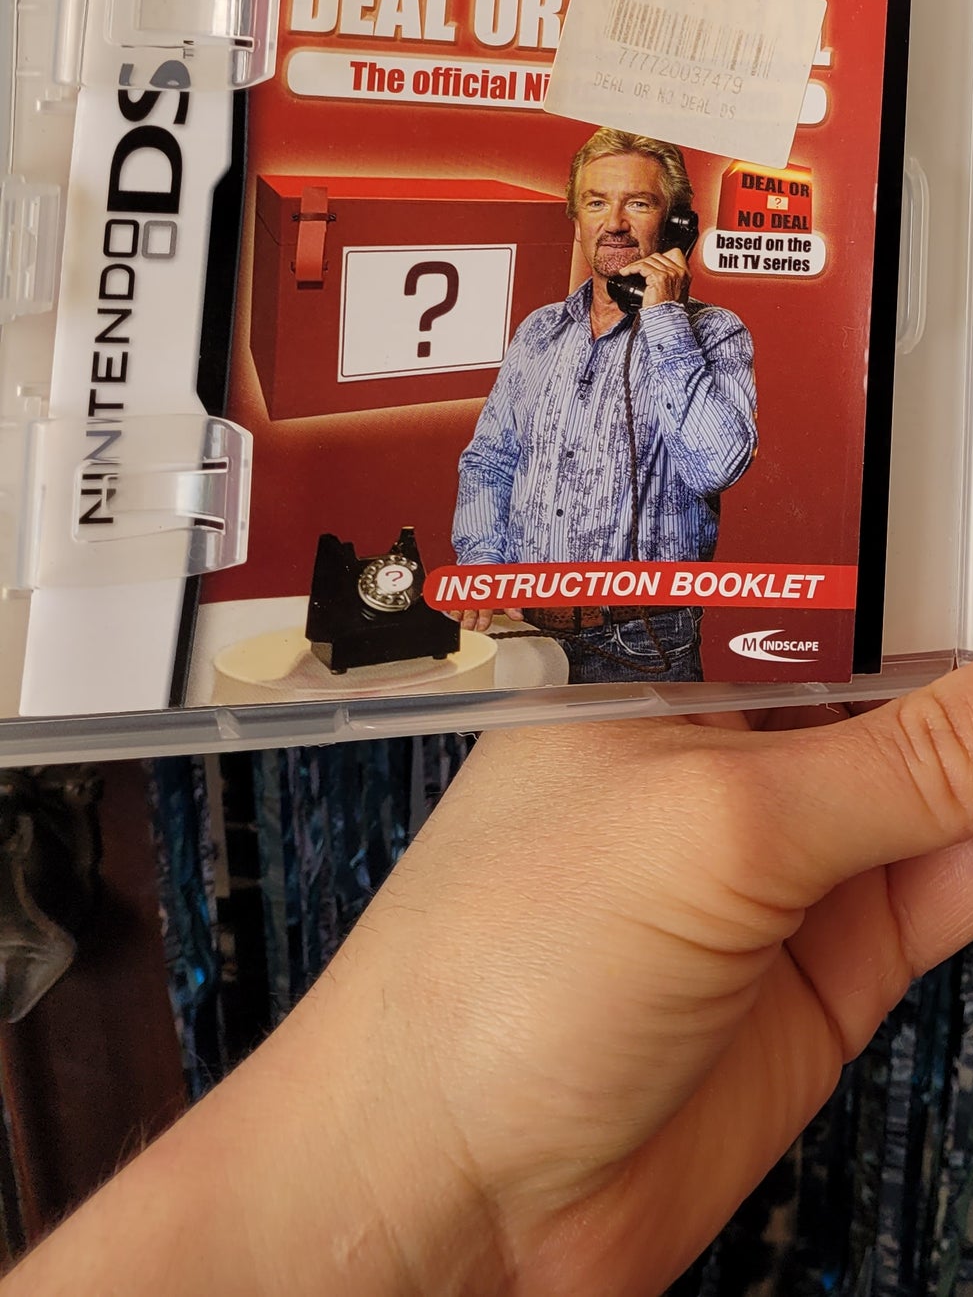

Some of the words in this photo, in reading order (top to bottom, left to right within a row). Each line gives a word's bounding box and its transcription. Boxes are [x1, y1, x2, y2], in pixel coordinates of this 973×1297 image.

[350, 60, 405, 94] The
[412, 66, 516, 102] official
[594, 72, 624, 94] DEAL
[633, 82, 651, 99] OR
[741, 173, 785, 194] DEAL
[789, 181, 810, 198] OR
[737, 210, 765, 228] NO
[771, 213, 809, 230] DEAL
[716, 233, 763, 251] based
[765, 238, 784, 252] on
[787, 237, 812, 253] the
[718, 253, 739, 269] hit
[742, 254, 761, 270] TV
[763, 256, 811, 272] series
[435, 571, 661, 601] INSTRUCTION
[669, 572, 825, 599] BOOKLET
[741, 637, 820, 653] MINDSCAPE
